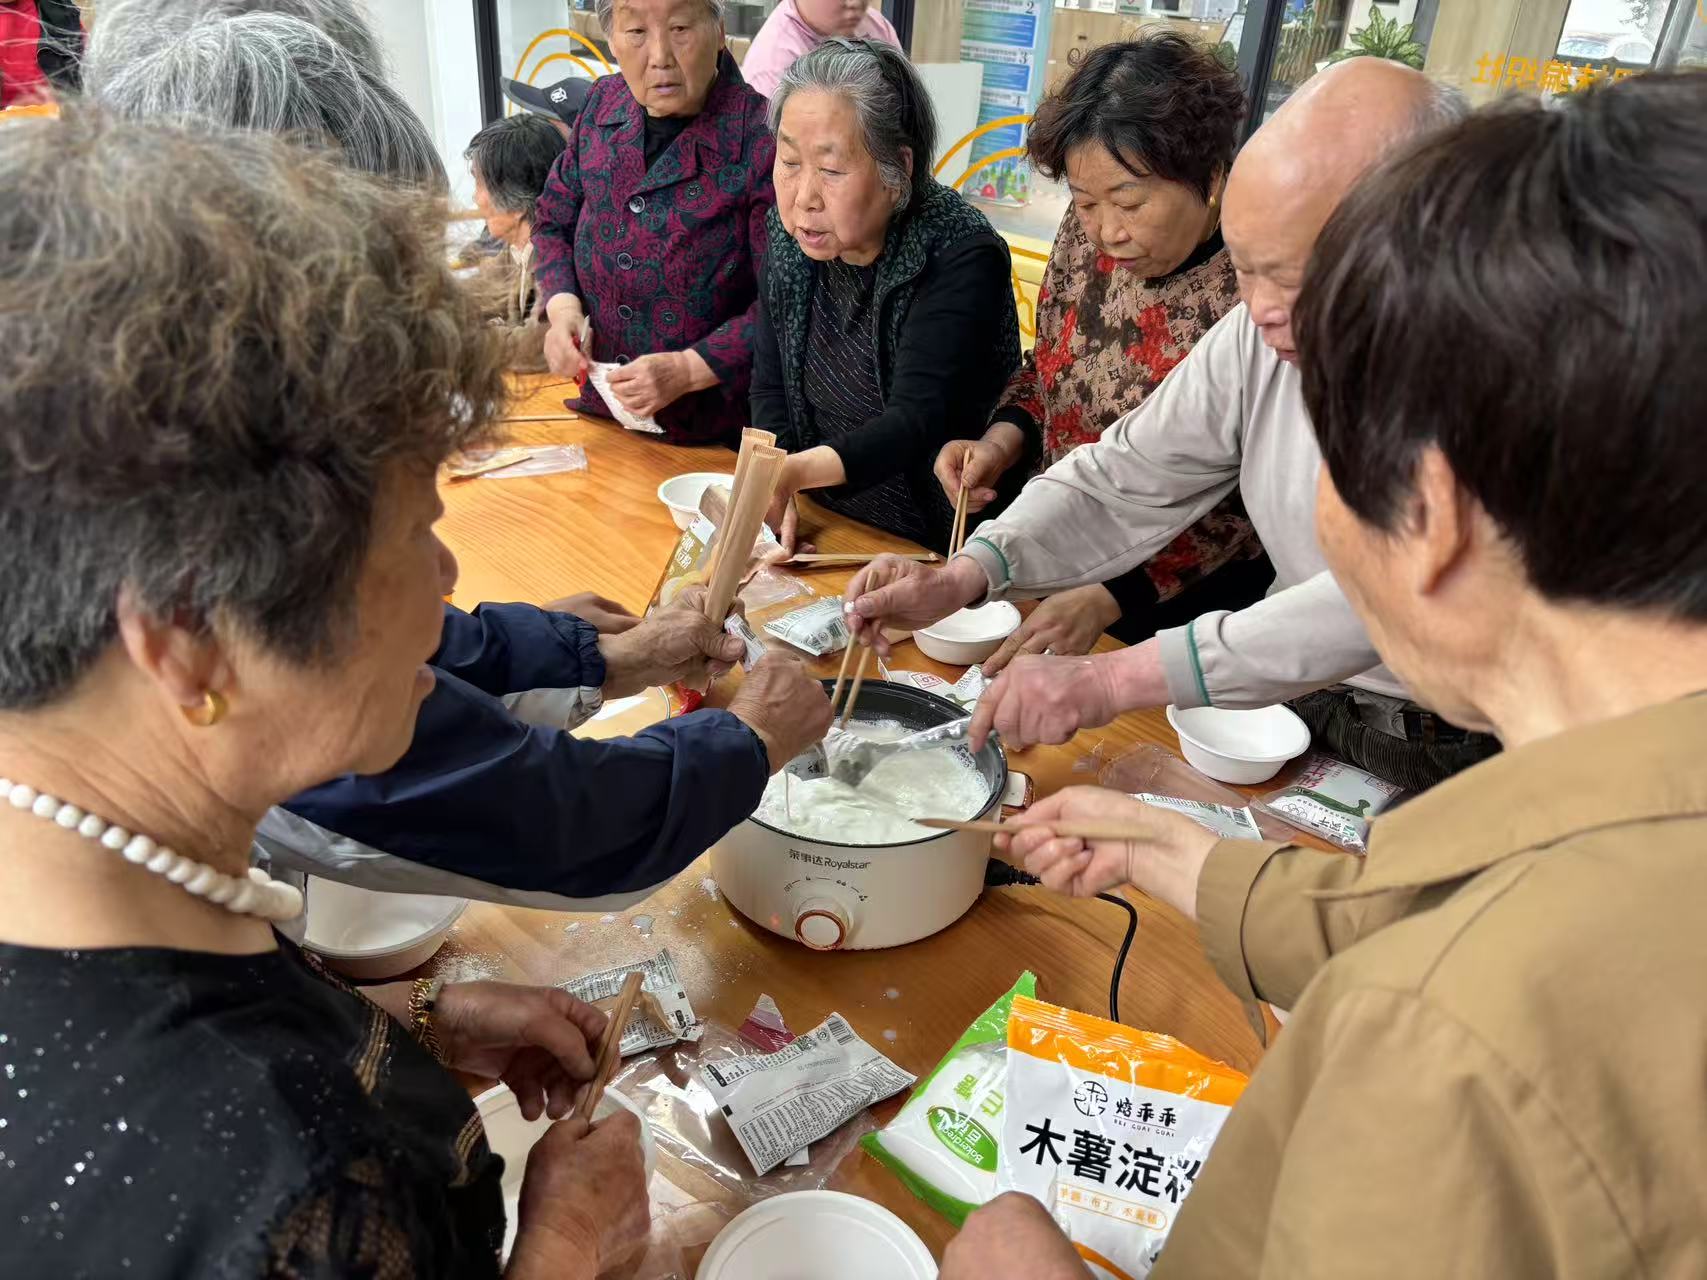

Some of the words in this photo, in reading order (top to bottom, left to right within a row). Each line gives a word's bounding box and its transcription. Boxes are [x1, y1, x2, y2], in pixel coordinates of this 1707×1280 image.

[1025, 1, 1034, 14] 2
[788, 848, 823, 866] 荣事达
[824, 857, 871, 870] Royalstar
[1115, 1097, 1177, 1127] 焙乖乖
[1019, 1118, 1201, 1204] 木薯淀粉
